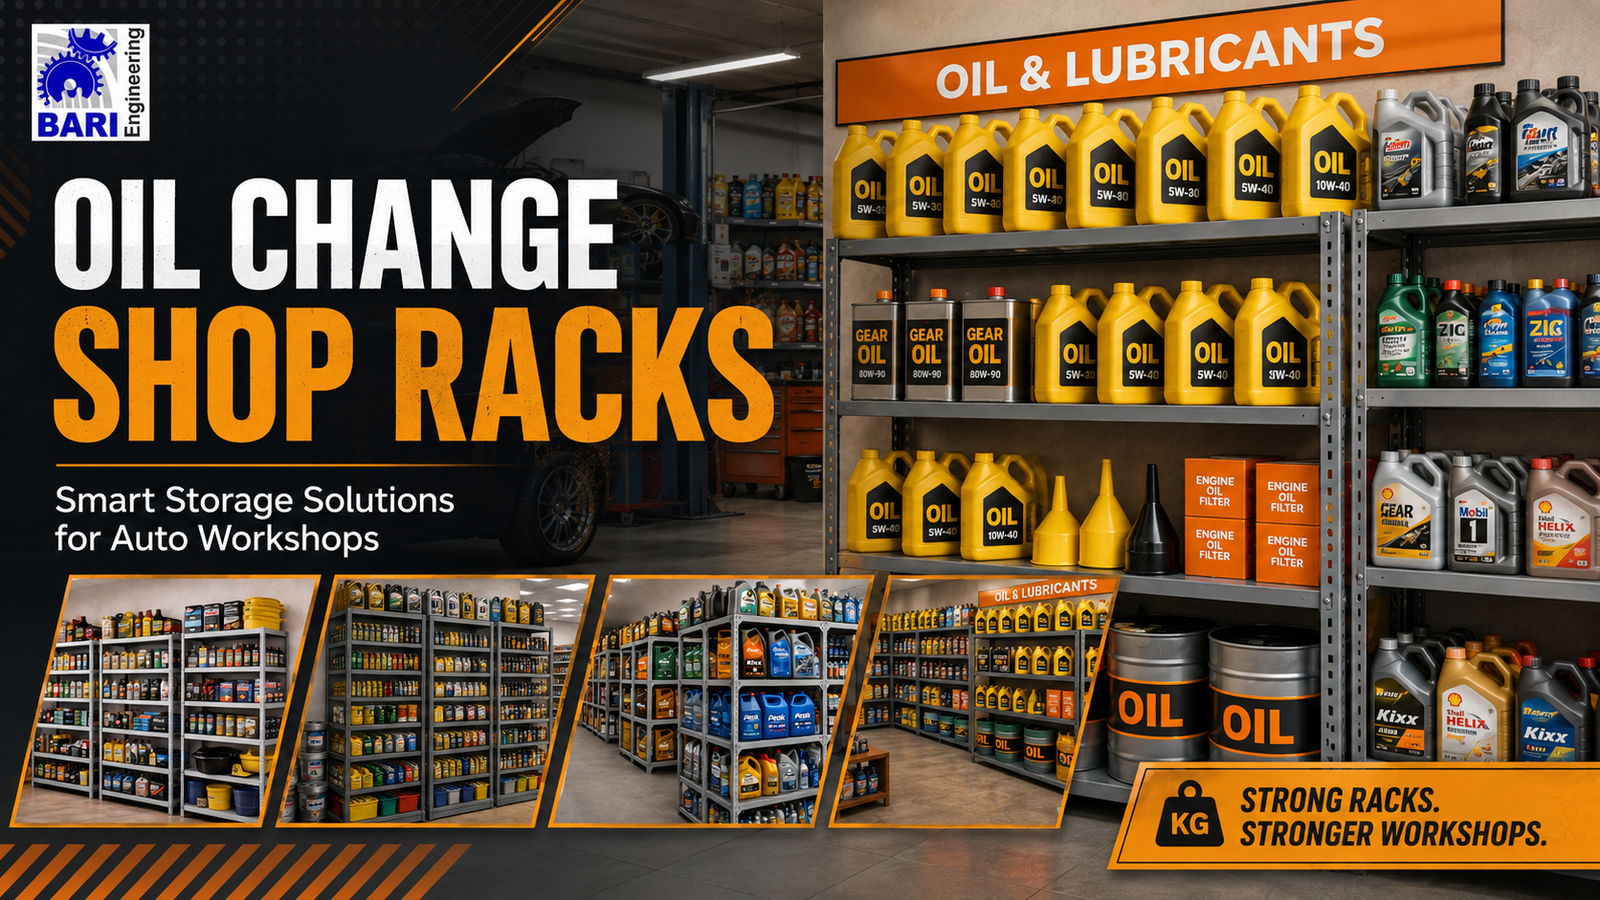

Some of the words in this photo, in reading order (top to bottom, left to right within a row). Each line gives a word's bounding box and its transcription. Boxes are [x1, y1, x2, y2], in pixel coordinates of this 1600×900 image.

[936, 59, 1008, 99] OIL
[1019, 54, 1051, 92] &
[1066, 17, 1386, 87] LUBRICANTS
[1165, 158, 1201, 182] OIL
[1238, 153, 1274, 178] OIL
[1313, 150, 1351, 176] OIL
[1029, 166, 1064, 190] OIL
[1094, 162, 1129, 186] OIL
[854, 179, 886, 200] OIL
[909, 175, 943, 198] OIL
[968, 171, 1002, 194] OIL
[1241, 182, 1274, 195] 5W-40
[1315, 179, 1351, 192] 10W-40
[1096, 189, 1129, 202] 5W-30
[1168, 186, 1200, 198] 5W-30
[912, 201, 942, 212] 5W-30
[855, 328, 888, 342] GEAR
[909, 328, 944, 342] GEAR
[966, 327, 1004, 342] GEAR
[857, 344, 886, 365] OIL
[911, 344, 942, 365] OIL
[968, 344, 1002, 364] OIL
[1063, 342, 1096, 365] OIL
[1126, 342, 1160, 365] OIL
[1194, 342, 1229, 364] OIL
[1265, 340, 1302, 364] OIL
[912, 370, 942, 379] 80W-90
[970, 370, 1002, 379] 80W-90
[1128, 370, 1160, 380] 5W-40
[1197, 370, 1229, 380] 5W-40
[1196, 475, 1235, 486] ENGINE
[1267, 481, 1308, 492] ENGINE
[1206, 486, 1223, 496] OIL
[1278, 492, 1296, 502] OIL
[1199, 496, 1230, 506] FILTER
[1270, 502, 1304, 514] FILTER
[869, 501, 900, 520] OIL
[926, 504, 958, 524] OIL
[986, 507, 1018, 527] OIL
[1459, 506, 1488, 518] Mobil
[1469, 520, 1477, 542] 1
[1538, 522, 1576, 532] HELIX
[988, 530, 1018, 540] 10W-40
[1196, 529, 1235, 540] ENGINE
[1267, 536, 1308, 547] ENGINE
[1206, 540, 1223, 550] OIL
[1278, 546, 1296, 557] OIL
[1199, 550, 1230, 560] FILTER
[1270, 557, 1304, 568] FILTER
[994, 592, 1010, 602] OIL
[1021, 579, 1098, 598] LUBRICANTS
[1118, 690, 1184, 728] OIL
[1376, 708, 1420, 726] Kixx
[1446, 716, 1489, 730] HELIX
[1222, 704, 1294, 745] OIL
[1523, 726, 1569, 744] Kixx
[995, 739, 1010, 750] OIL
[1026, 746, 1044, 758] OIL
